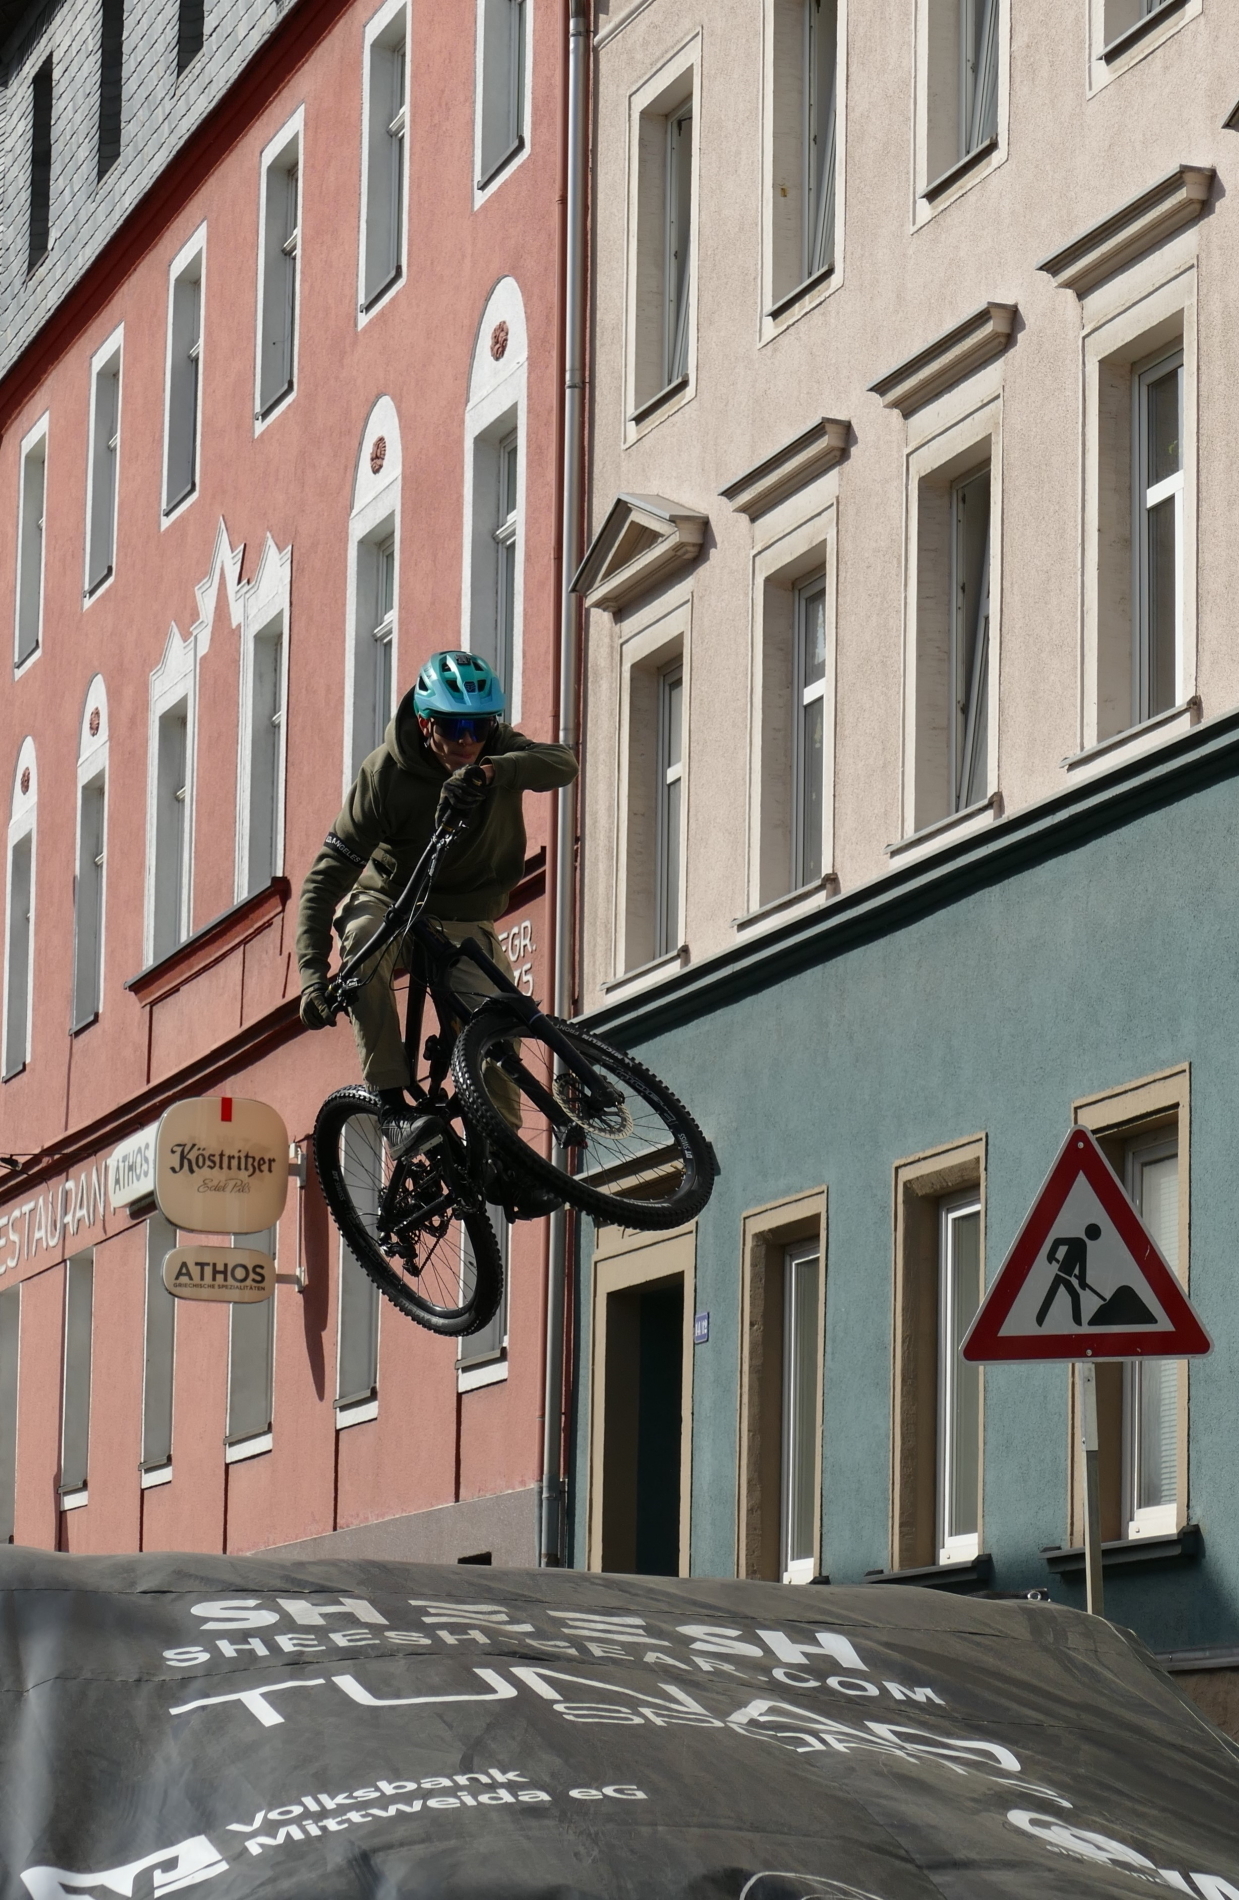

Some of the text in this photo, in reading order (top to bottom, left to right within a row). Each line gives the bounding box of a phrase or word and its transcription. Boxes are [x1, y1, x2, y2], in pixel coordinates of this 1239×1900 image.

[332, 837, 361, 863] ANGELES
[556, 1023, 624, 1060] MICHELIN FRONT
[677, 1133, 691, 1151] SWISS
[113, 1142, 150, 1195] ATHOS
[169, 1143, 276, 1176] Köstritzer
[197, 1178, 251, 1194] Edel Pils
[173, 1282, 266, 1292] GRIECHISCHE SPEZIALITÄTEN
[174, 1261, 266, 1284] ATHOS
[226, 1768, 531, 1834] Volksbank
[244, 1784, 649, 1856] Mittweida eG
